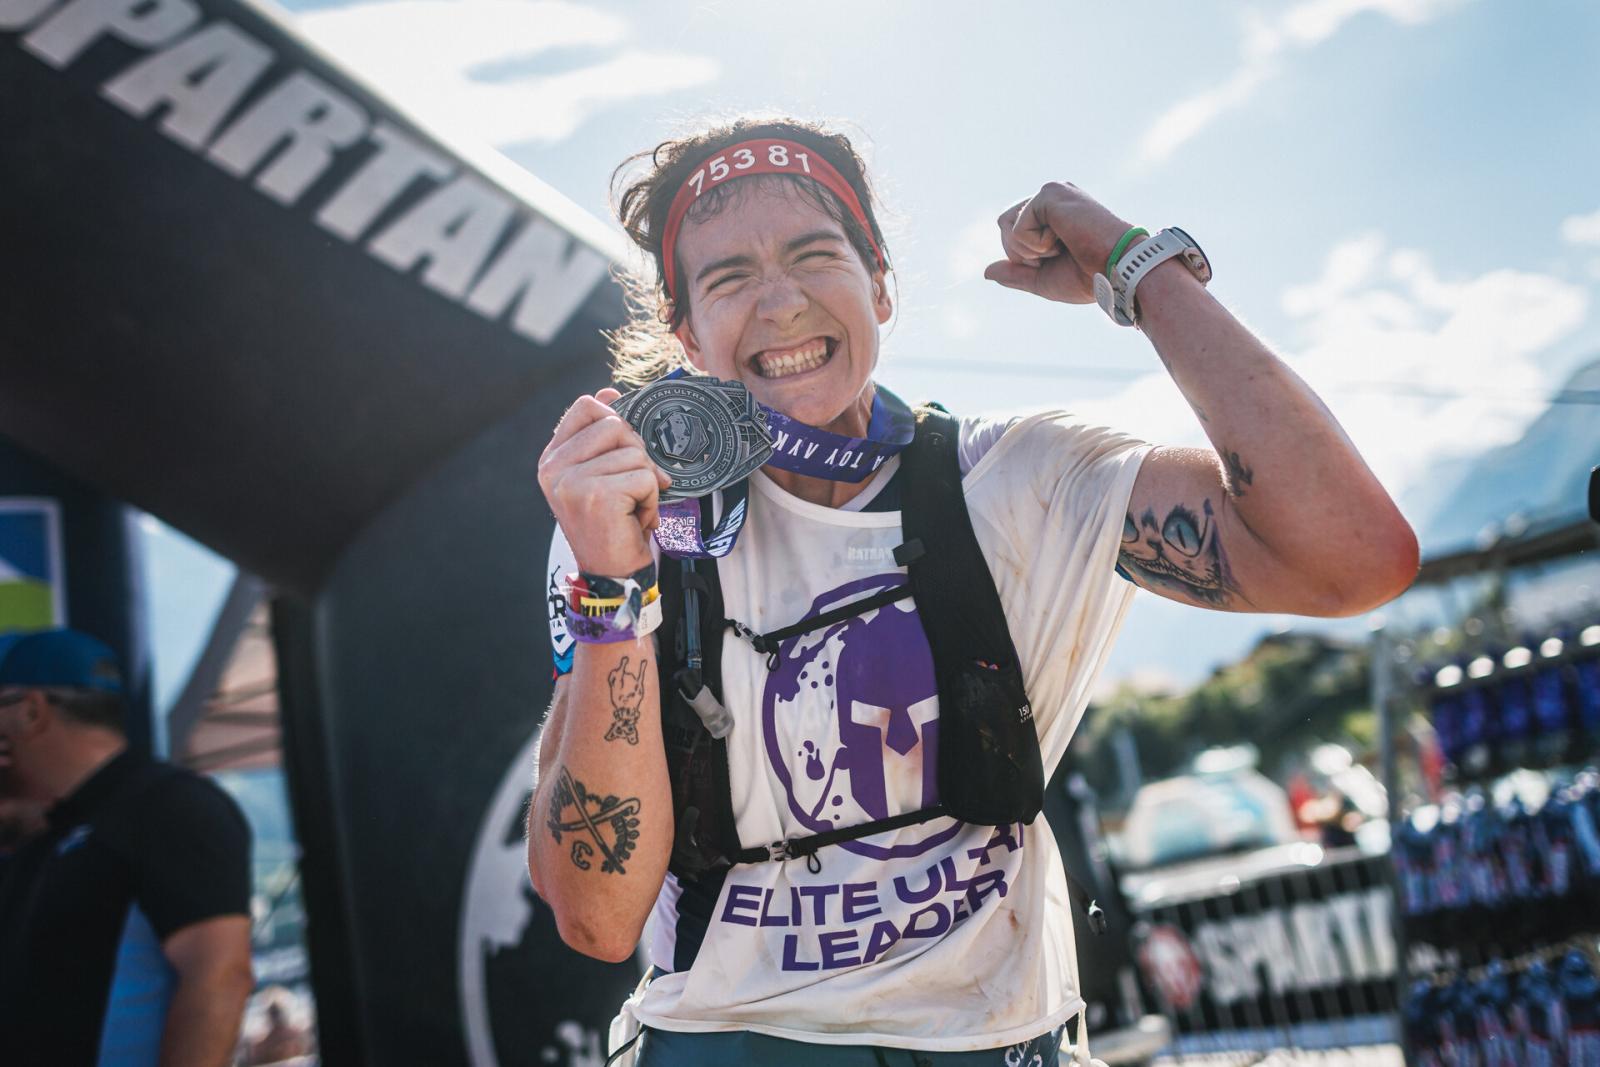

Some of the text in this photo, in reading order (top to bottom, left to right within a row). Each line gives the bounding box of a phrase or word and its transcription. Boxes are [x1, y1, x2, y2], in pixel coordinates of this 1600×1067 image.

[634, 388, 706, 419] SPARTAN ULTRA
[767, 425, 819, 459] ΛΥΚ
[681, 473, 717, 488] 2026
[720, 822, 1024, 927] ELITE ULTR
